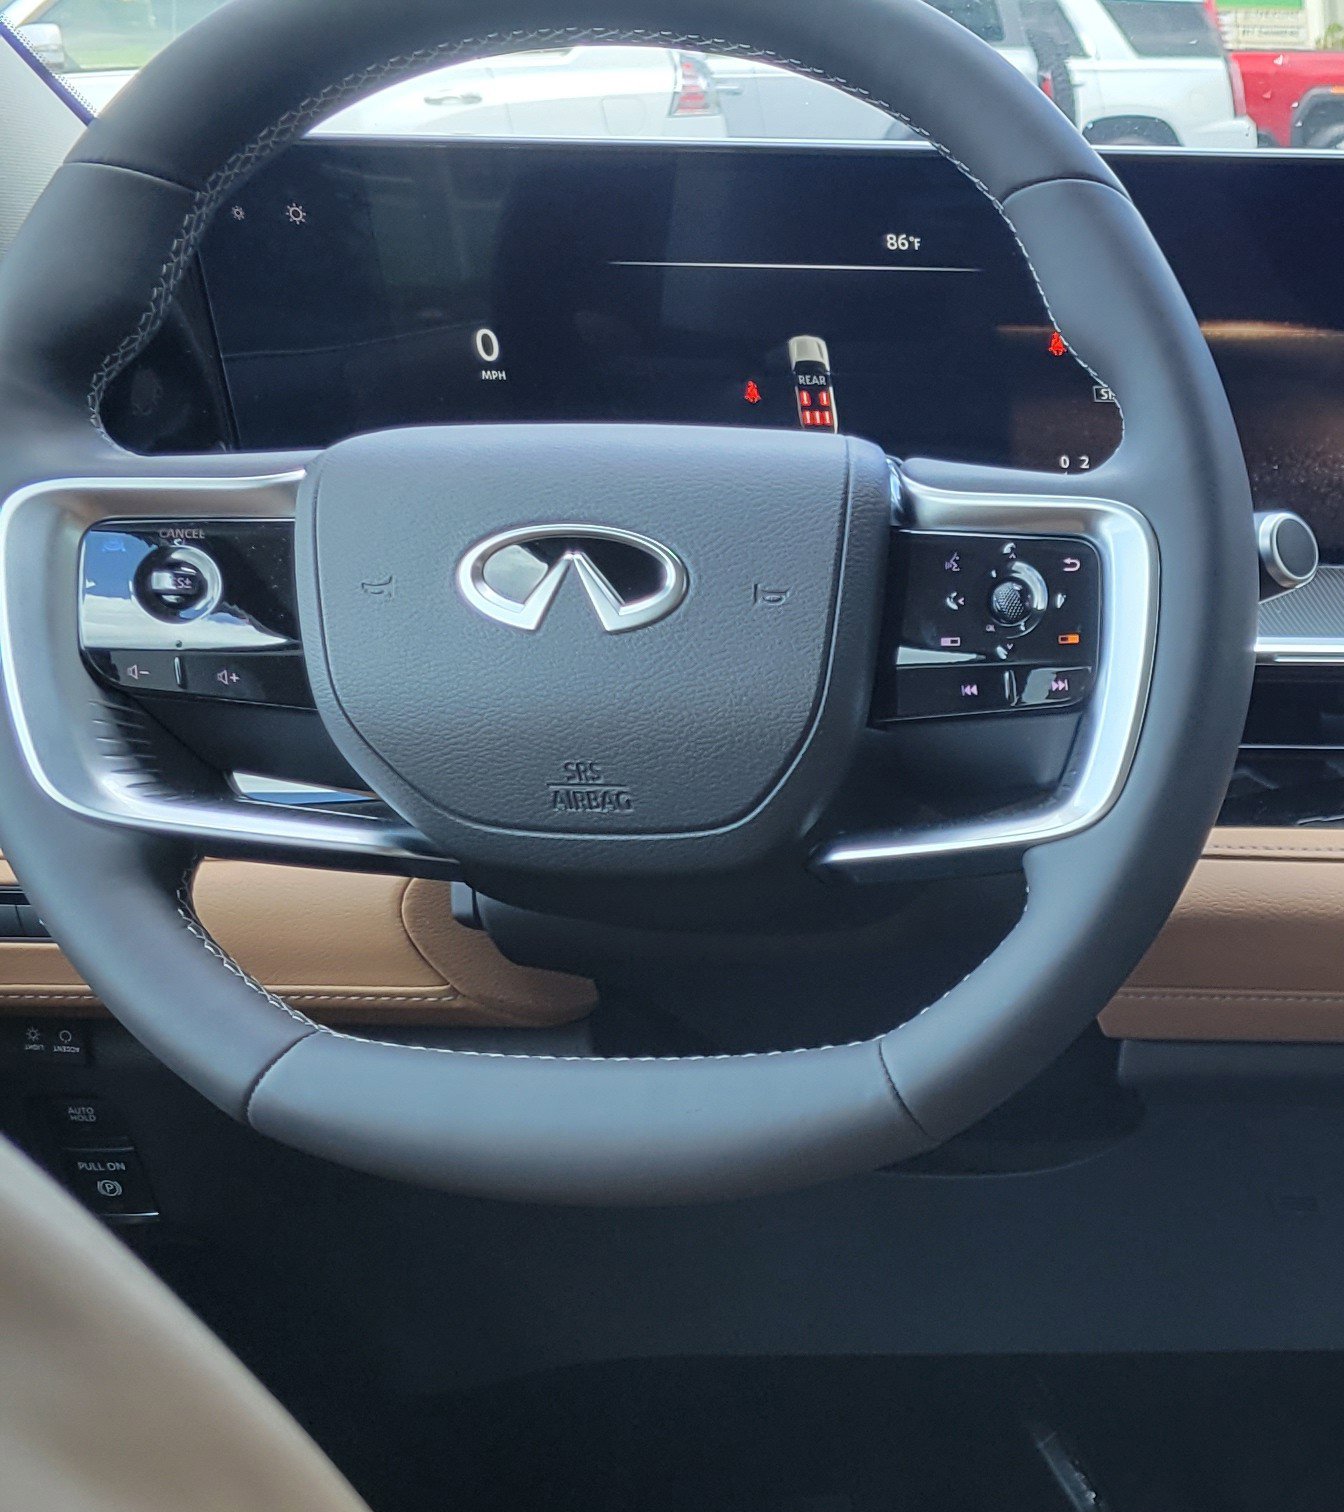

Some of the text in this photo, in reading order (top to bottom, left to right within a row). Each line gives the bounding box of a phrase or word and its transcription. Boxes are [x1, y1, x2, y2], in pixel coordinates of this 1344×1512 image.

[886, 234, 921, 251] 86°F
[475, 328, 500, 362] 0
[481, 370, 507, 381] MPH
[798, 374, 827, 387] REAR
[1080, 456, 1090, 469] 2
[160, 528, 206, 539] CANCEL
[563, 760, 604, 784] SRS
[552, 789, 635, 814] AIRBAG
[53, 1045, 80, 1053] ACCENT
[68, 1107, 94, 1115] AUTO
[70, 1114, 96, 1122] HOLD
[77, 1162, 126, 1171] PULL ON
